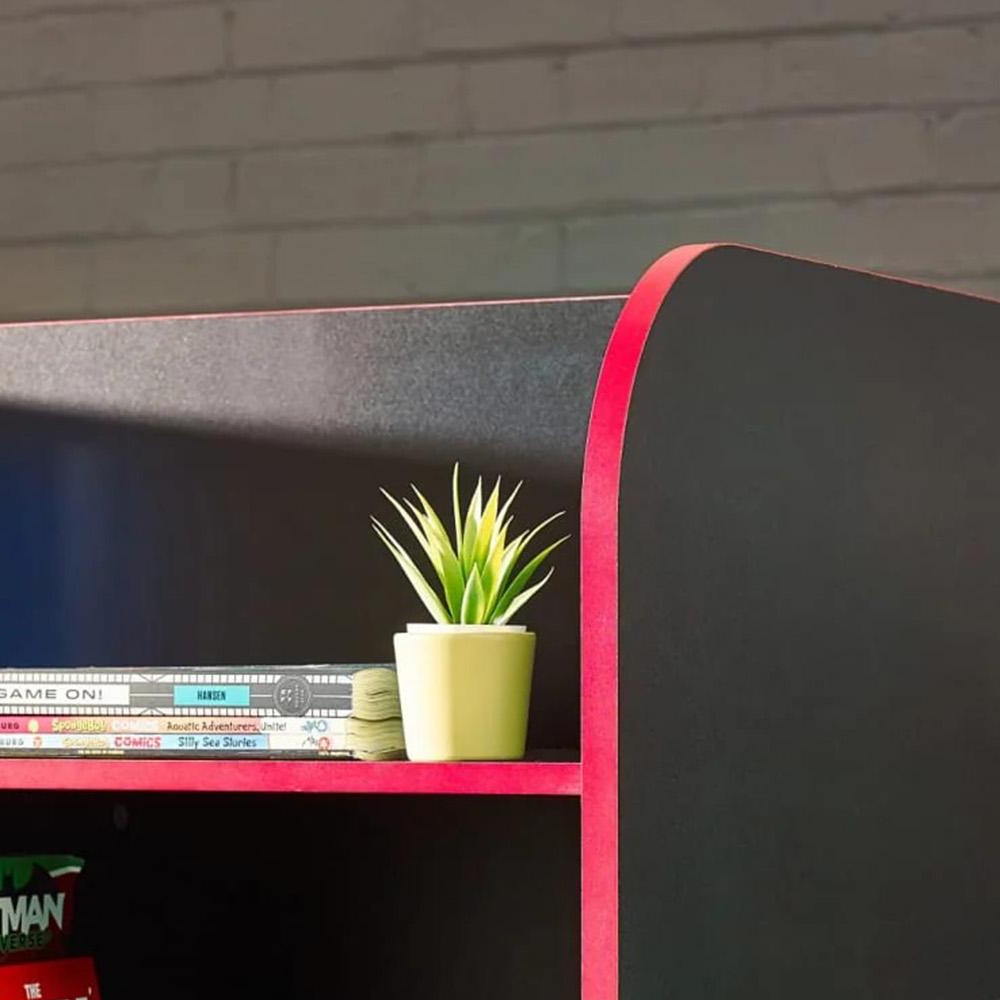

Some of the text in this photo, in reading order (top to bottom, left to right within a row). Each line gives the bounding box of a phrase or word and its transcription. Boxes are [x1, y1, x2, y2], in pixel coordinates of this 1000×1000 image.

[66, 688, 103, 699] ON!
[197, 690, 227, 700] HANSEN
[114, 736, 162, 748] COMICS
[202, 737, 221, 748] Sea
[24, 983, 42, 1000] THE
